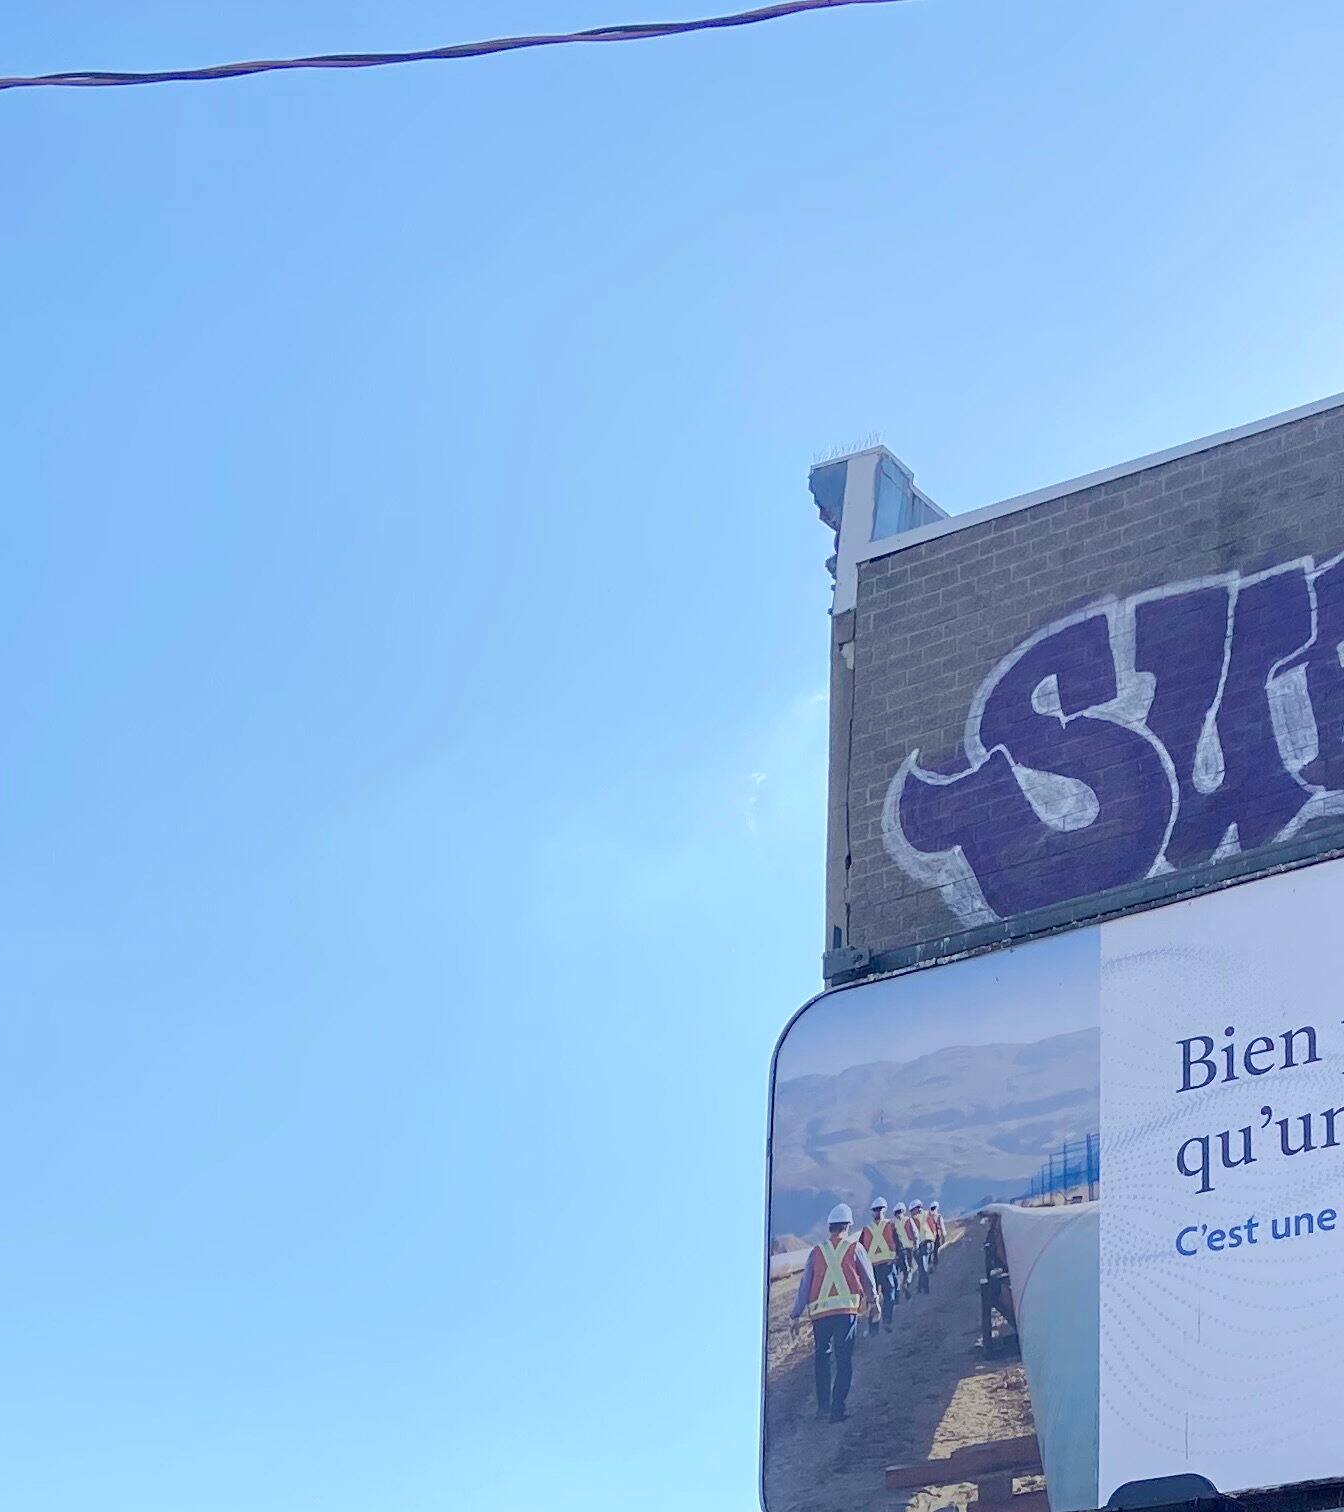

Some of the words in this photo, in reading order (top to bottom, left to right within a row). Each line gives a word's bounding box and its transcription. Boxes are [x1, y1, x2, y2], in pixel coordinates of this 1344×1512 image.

[1176, 1021, 1323, 1094] Bien
[1175, 1216, 1260, 1258] C'est
[1271, 1205, 1338, 1240] une
